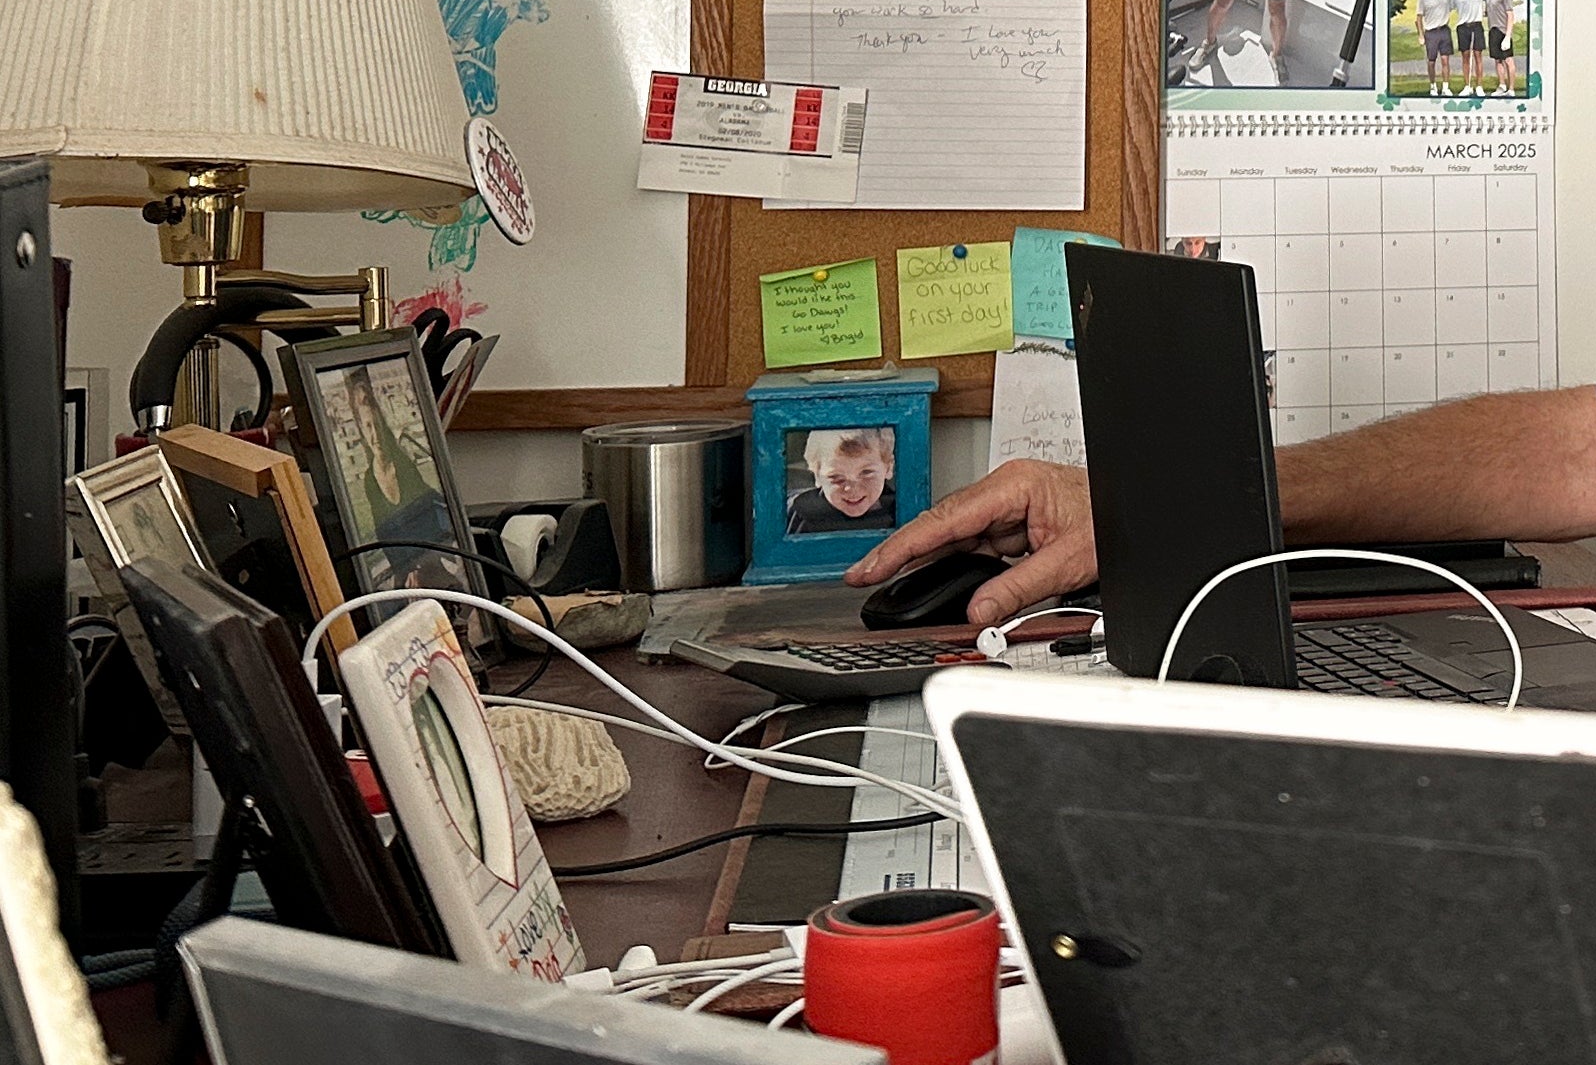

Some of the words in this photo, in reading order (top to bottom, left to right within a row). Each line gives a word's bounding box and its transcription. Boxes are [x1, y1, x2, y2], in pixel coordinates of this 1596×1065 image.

[918, 4, 939, 19] so
[707, 78, 768, 97] GEORGIA
[806, 104, 819, 112] KK
[1426, 144, 1493, 160] MARCH
[1497, 143, 1537, 159] 2025
[1176, 167, 1208, 177] Sunday
[1230, 166, 1264, 177] Monday
[1284, 165, 1318, 176] Tuesday
[1330, 165, 1378, 175] Wednesday
[1390, 164, 1424, 175] Thursday
[1447, 164, 1471, 175] Friday
[1493, 163, 1528, 173] Saturday
[907, 256, 958, 277] Good
[963, 255, 1000, 273] luck
[775, 287, 781, 296] I
[785, 283, 827, 295] thought
[832, 281, 851, 294] you
[916, 283, 944, 297] on
[949, 281, 992, 304] your
[776, 297, 807, 307] would
[812, 295, 831, 303] like
[1026, 302, 1058, 313] TRIP
[1287, 299, 1294, 307] 11
[1340, 297, 1348, 305] 12
[810, 304, 848, 318] Dawgs!
[908, 306, 954, 327] first
[961, 297, 1008, 328] day!
[781, 325, 788, 334] I
[793, 324, 812, 333] love
[816, 319, 840, 334] you!
[1022, 406, 1058, 424] Love
